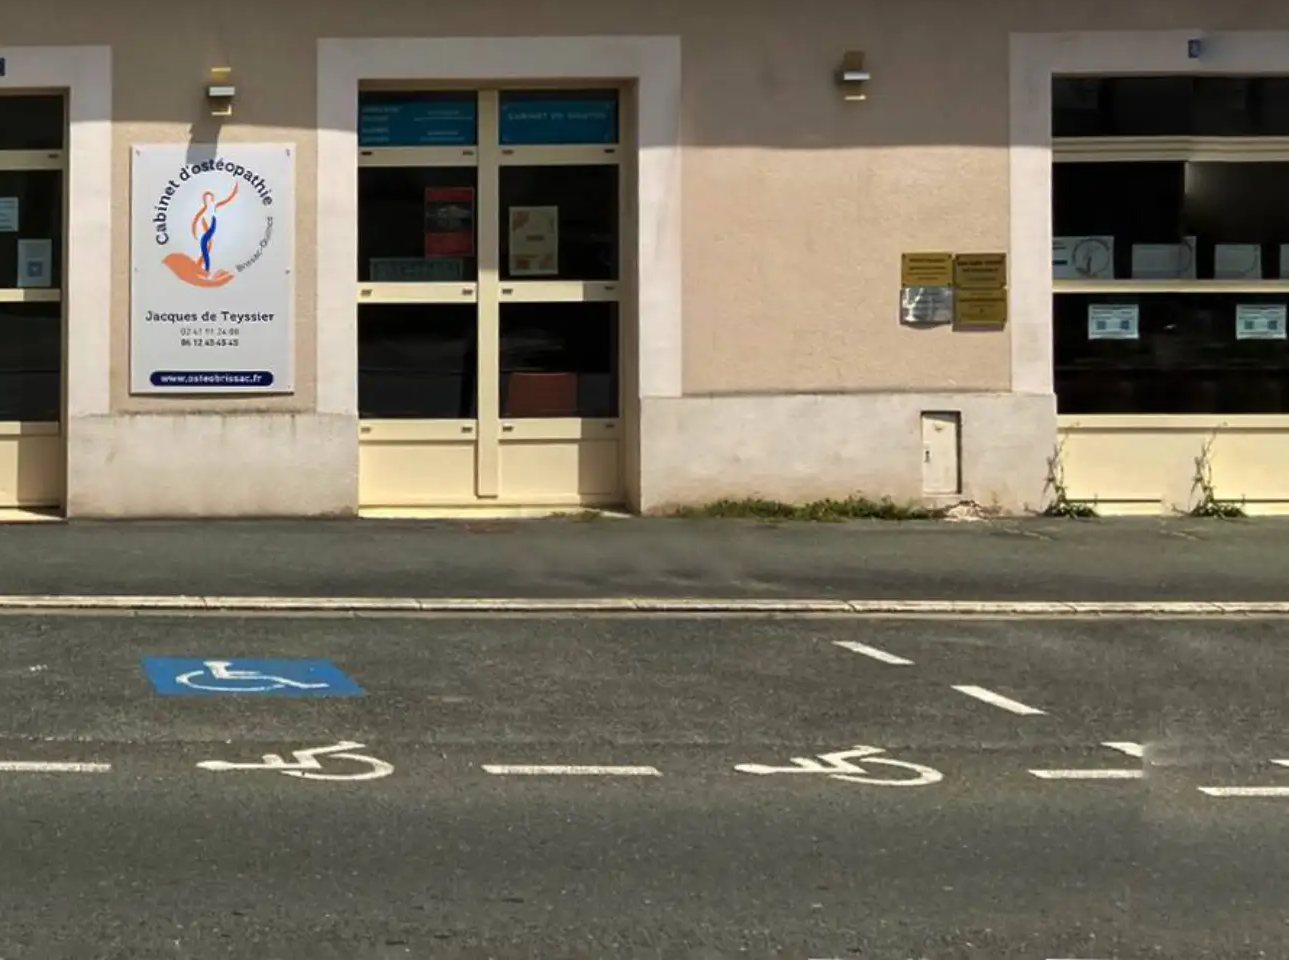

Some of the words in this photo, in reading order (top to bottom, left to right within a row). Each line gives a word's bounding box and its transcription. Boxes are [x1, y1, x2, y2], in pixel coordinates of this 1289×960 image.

[153, 180, 180, 245] Cabinet
[179, 157, 273, 206] d'ostéopathie
[145, 310, 198, 324] Jacques
[201, 310, 217, 321] de
[220, 311, 275, 324] Teyssier
[160, 373, 262, 383] www.osteobrissac.fr
